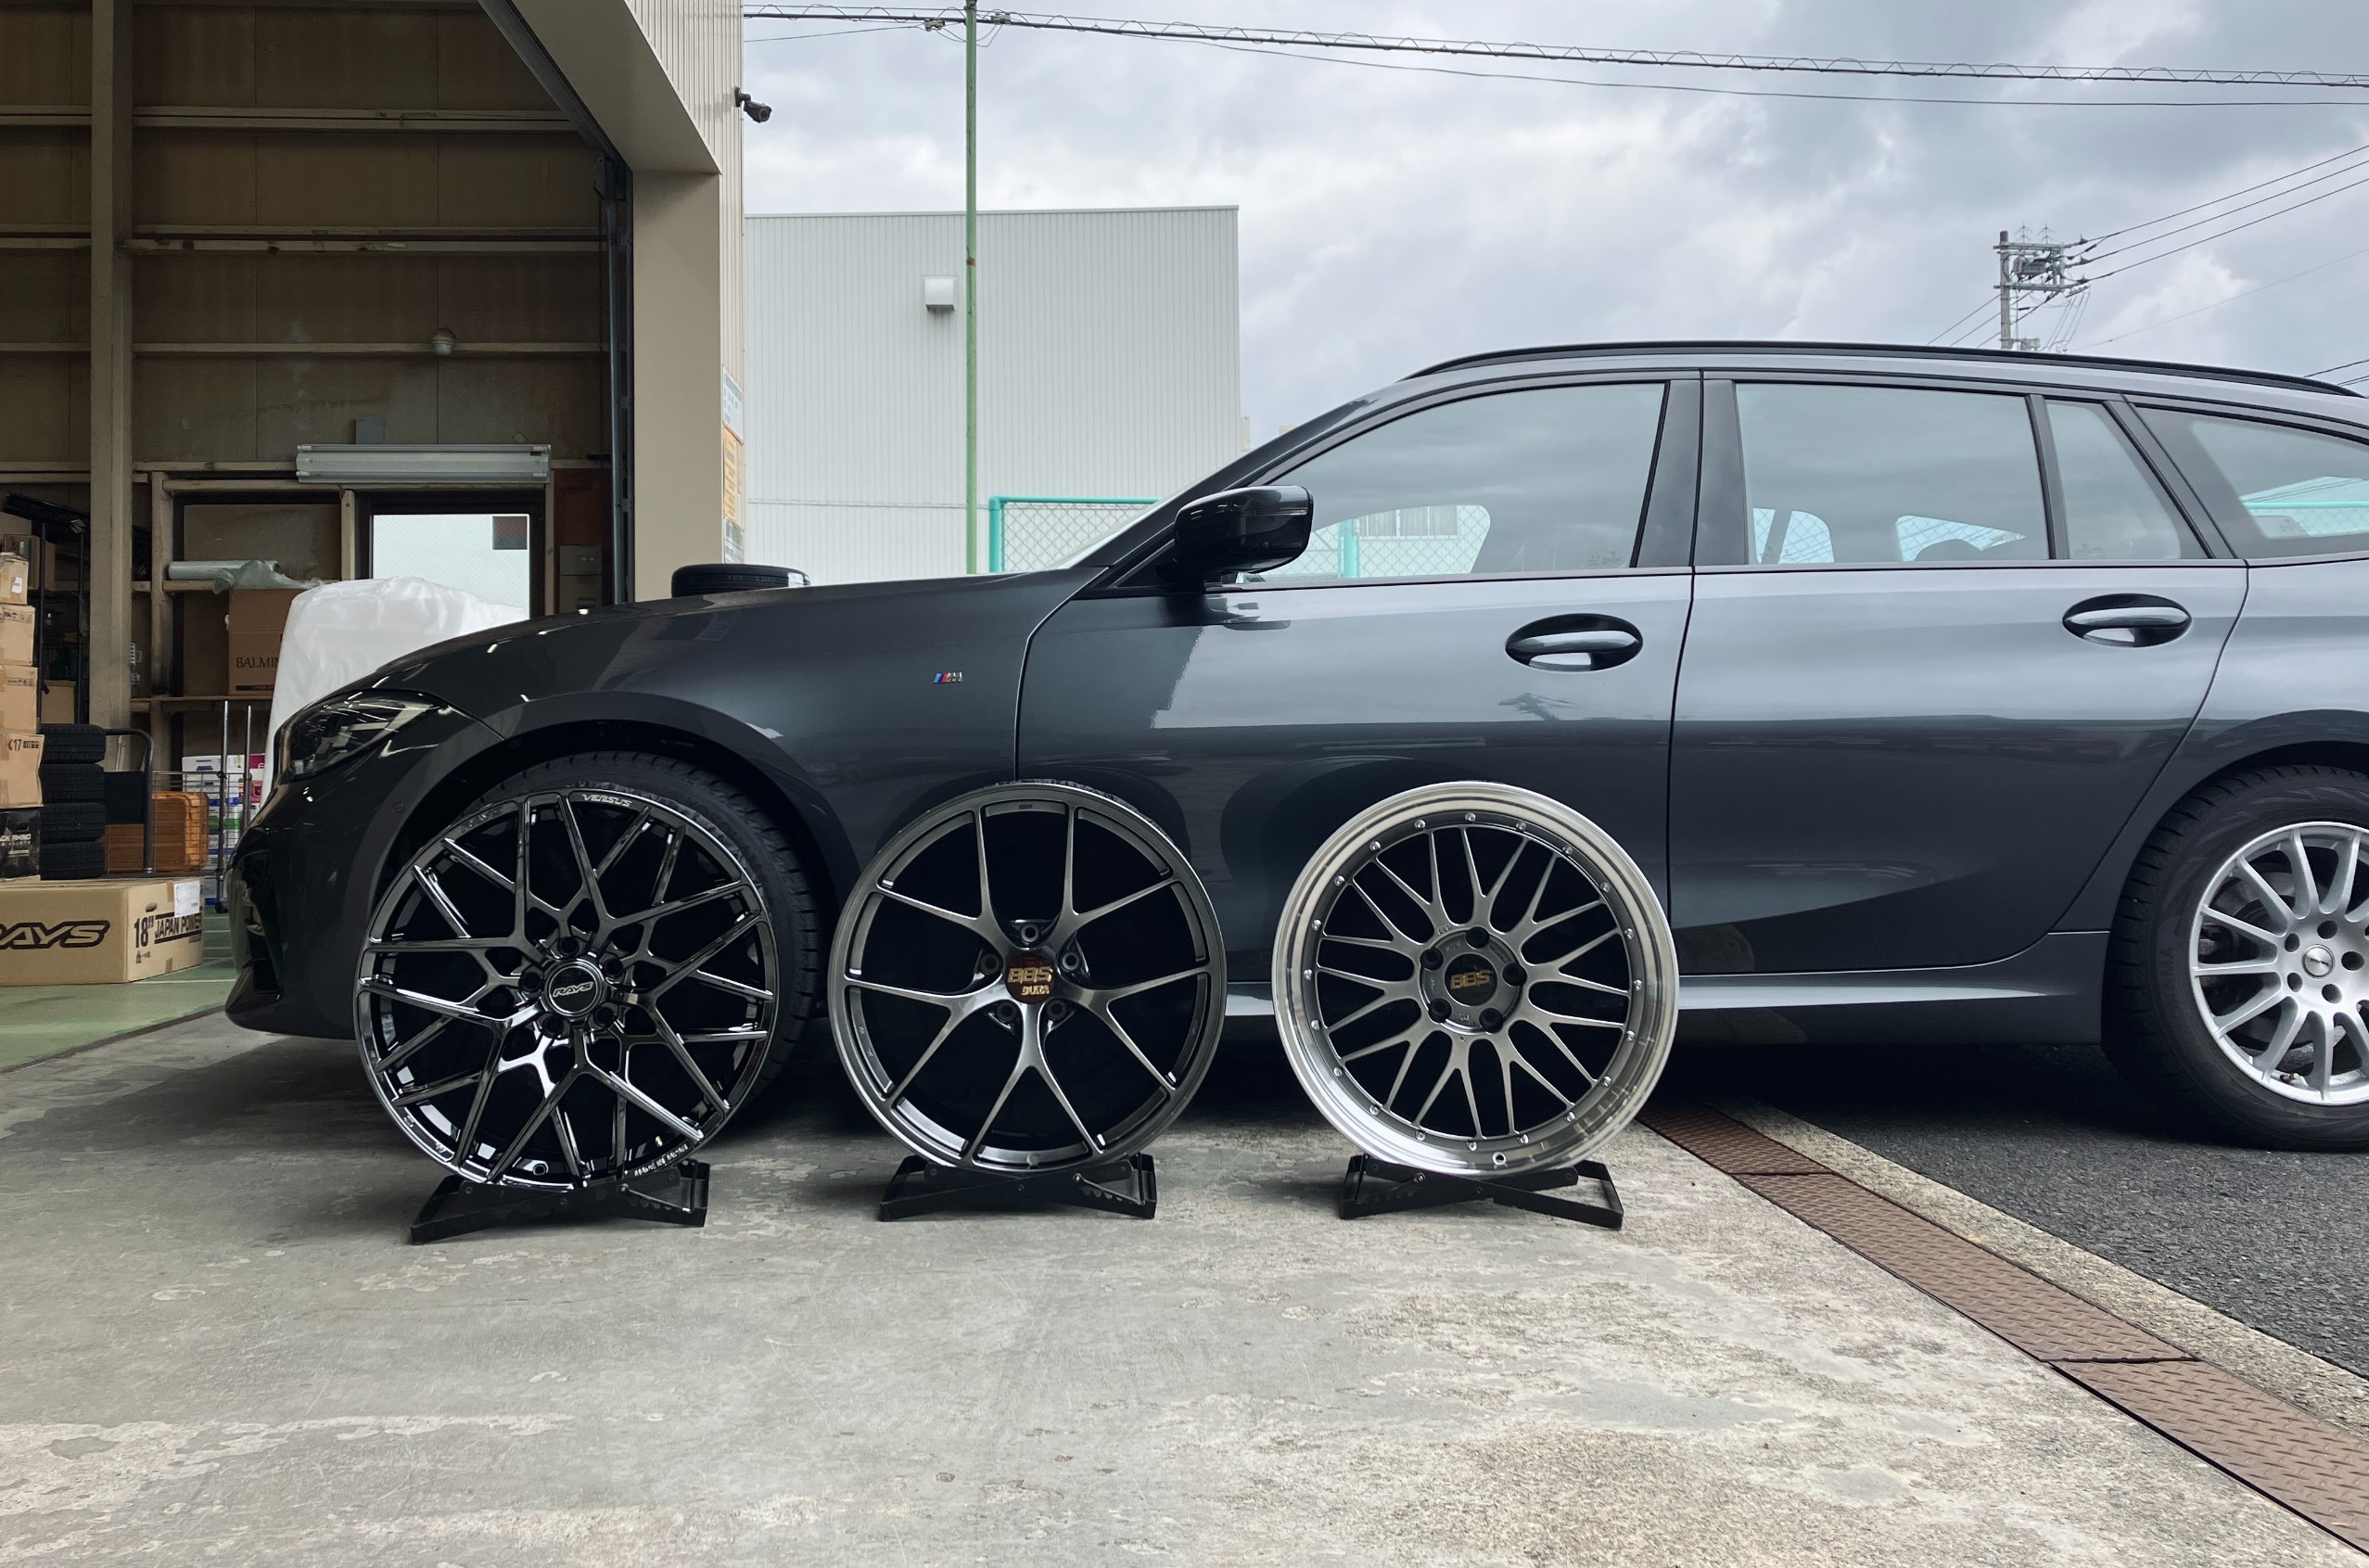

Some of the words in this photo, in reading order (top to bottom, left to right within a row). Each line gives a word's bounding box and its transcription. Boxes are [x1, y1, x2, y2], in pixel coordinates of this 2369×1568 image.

[581, 794, 632, 808] VERSUS
[155, 916, 180, 938] JAPAN
[181, 912, 202, 933] POWER
[0, 920, 110, 950] AYS
[1007, 966, 1053, 984] BBS
[1449, 969, 1494, 990] BBS
[552, 981, 593, 997] RAYS
